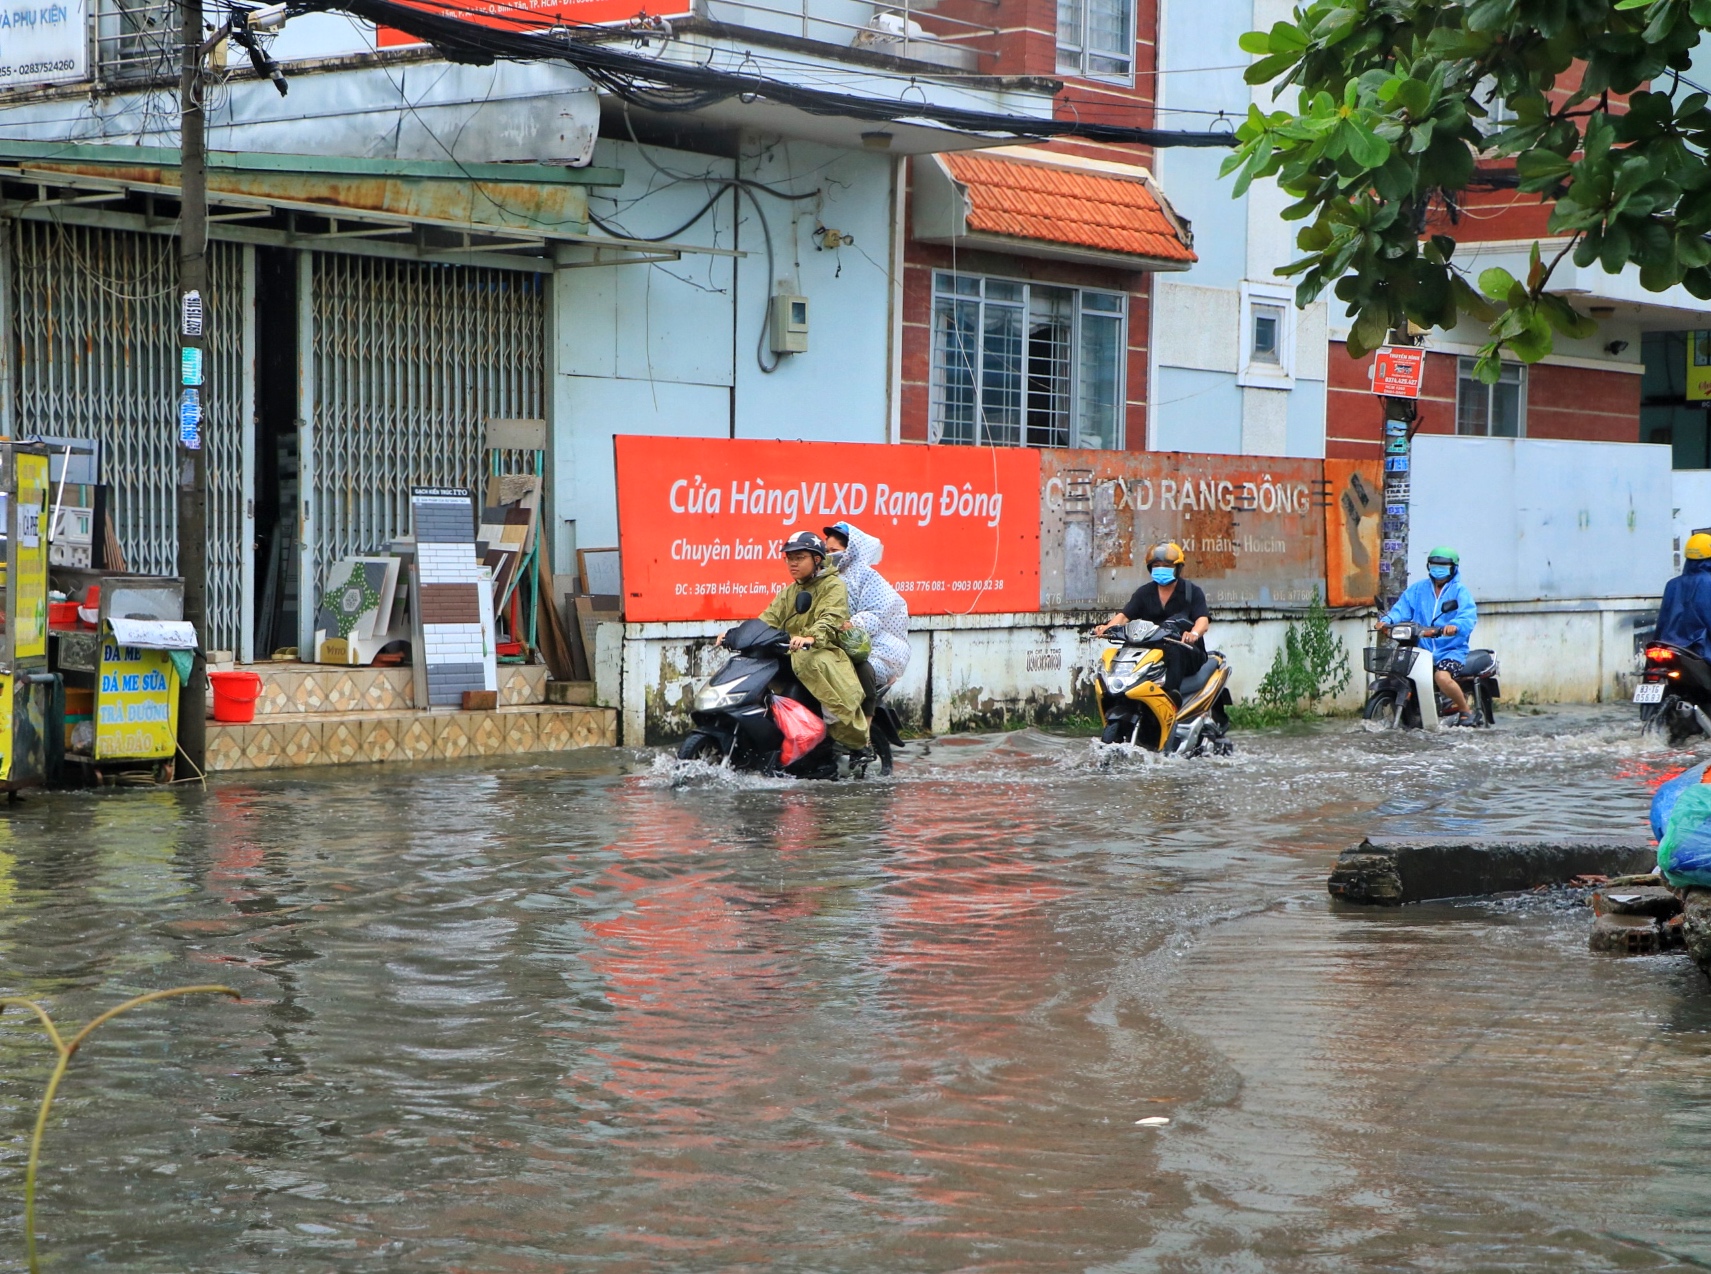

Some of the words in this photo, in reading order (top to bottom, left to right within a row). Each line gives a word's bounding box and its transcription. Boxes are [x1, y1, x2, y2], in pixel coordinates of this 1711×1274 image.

[0, 9, 11, 29] À
[13, 10, 37, 30] PHỤ
[40, 4, 67, 27] KIỆN
[19, 59, 75, 75] 02837524260
[669, 475, 722, 514] Cửa
[874, 483, 934, 526] Rạng
[939, 482, 1003, 527] Đông
[1160, 476, 1235, 520] RẠNG
[1243, 473, 1310, 514] ĐÔNG
[671, 538, 730, 567] Chuyên
[735, 538, 763, 560] bán
[1181, 535, 1195, 551] xi
[694, 583, 717, 595] 367B
[718, 580, 731, 594] Hồ
[732, 583, 748, 598] Học
[895, 581, 915, 591] 0838
[916, 581, 930, 591] 776
[931, 581, 946, 591] 081
[951, 580, 972, 591] 0903
[972, 580, 982, 591] 00
[994, 579, 1004, 590] 38
[125, 646, 142, 661] ME
[102, 671, 119, 692] ĐÁ
[122, 675, 140, 691] ME
[142, 669, 167, 691] SỮA
[100, 699, 125, 723] TRÀ
[97, 730, 122, 754] TRÀ
